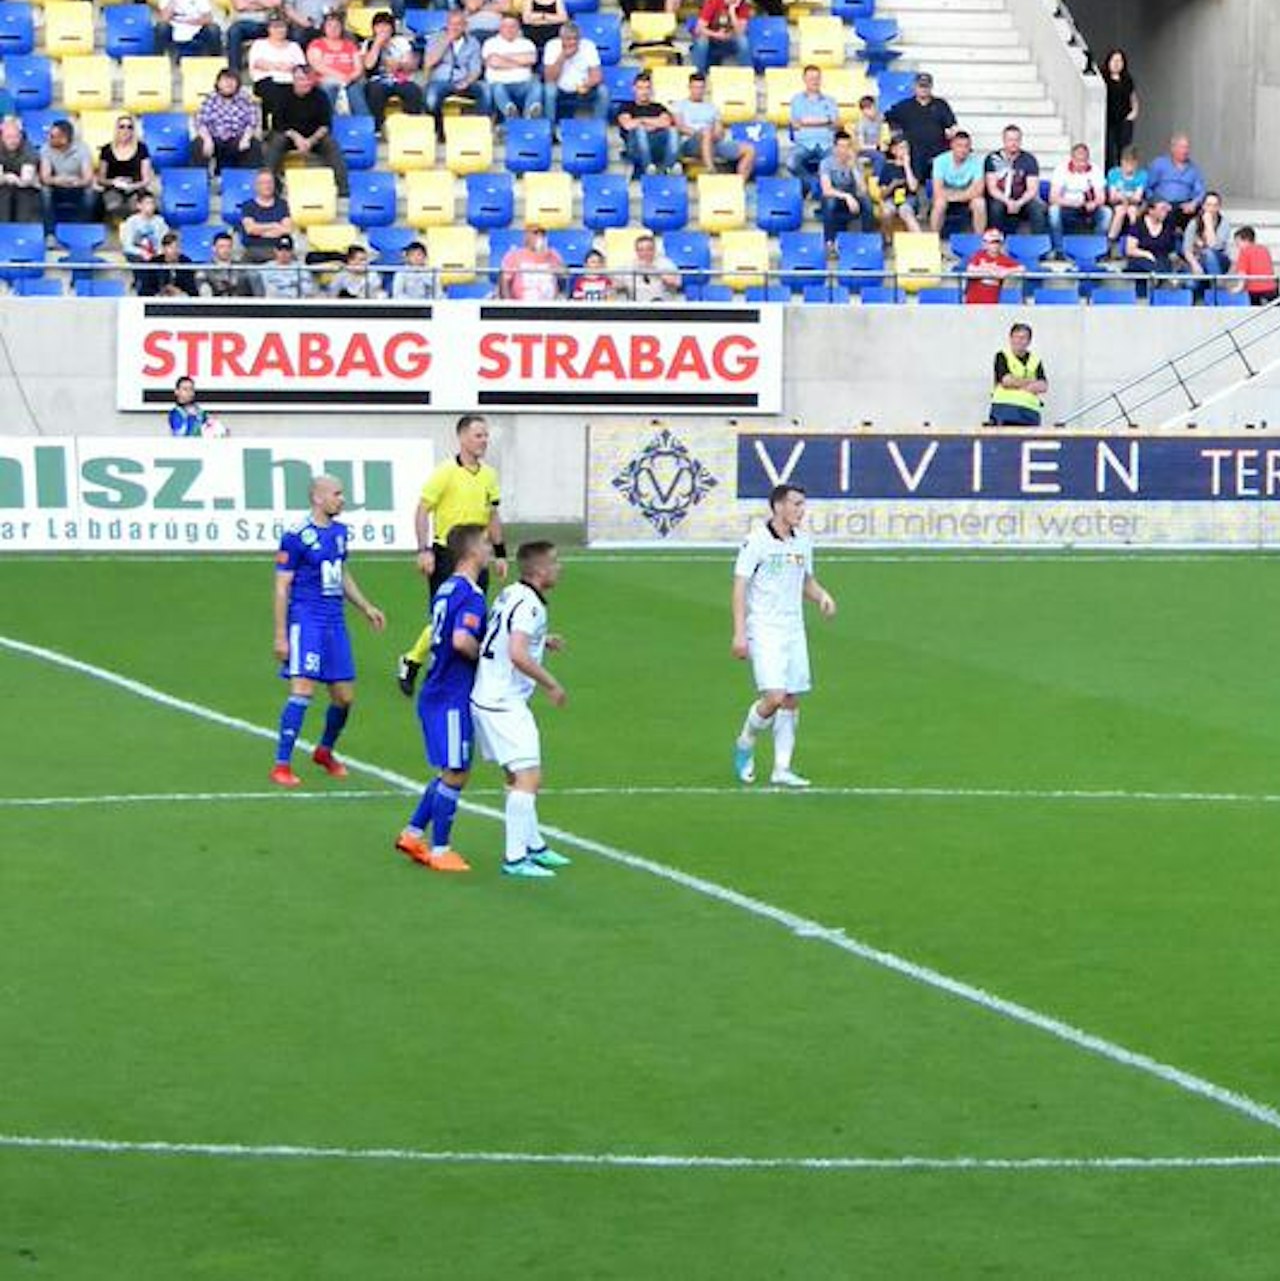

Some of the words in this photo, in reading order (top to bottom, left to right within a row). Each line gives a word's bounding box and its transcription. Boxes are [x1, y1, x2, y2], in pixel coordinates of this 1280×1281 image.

[142, 330, 432, 380] STRABAG
[477, 332, 759, 383] STRABAG
[755, 438, 1140, 494] VIVIEN
[887, 507, 1026, 536] mineral
[1037, 509, 1142, 537] water
